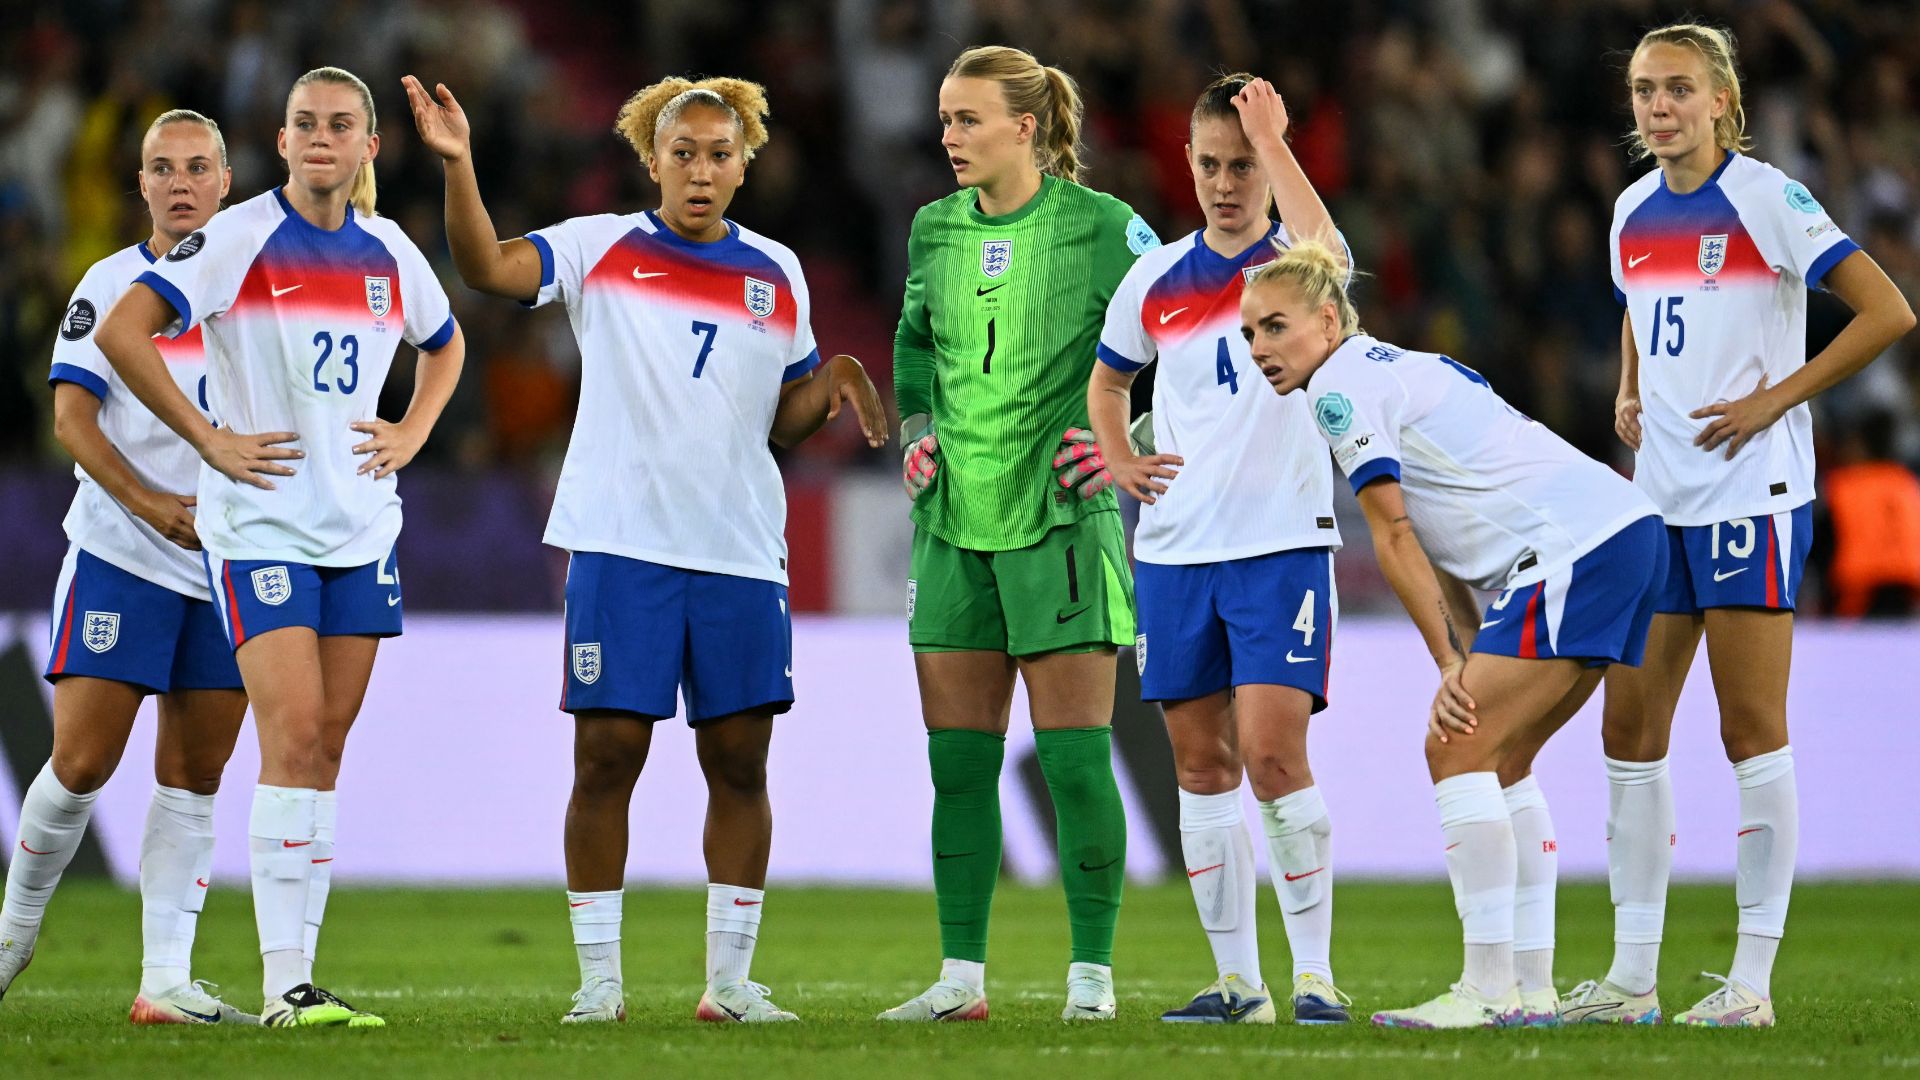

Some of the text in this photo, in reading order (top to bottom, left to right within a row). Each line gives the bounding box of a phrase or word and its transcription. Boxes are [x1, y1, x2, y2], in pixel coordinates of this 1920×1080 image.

[692, 320, 718, 378] 7
[983, 317, 995, 374] 1
[1650, 296, 1684, 357] 15
[313, 331, 358, 394] 23
[1217, 336, 1238, 395] 4
[377, 547, 400, 585] 2
[1712, 517, 1755, 559] 15
[1065, 544, 1079, 602] 1
[1292, 589, 1316, 646] 4
